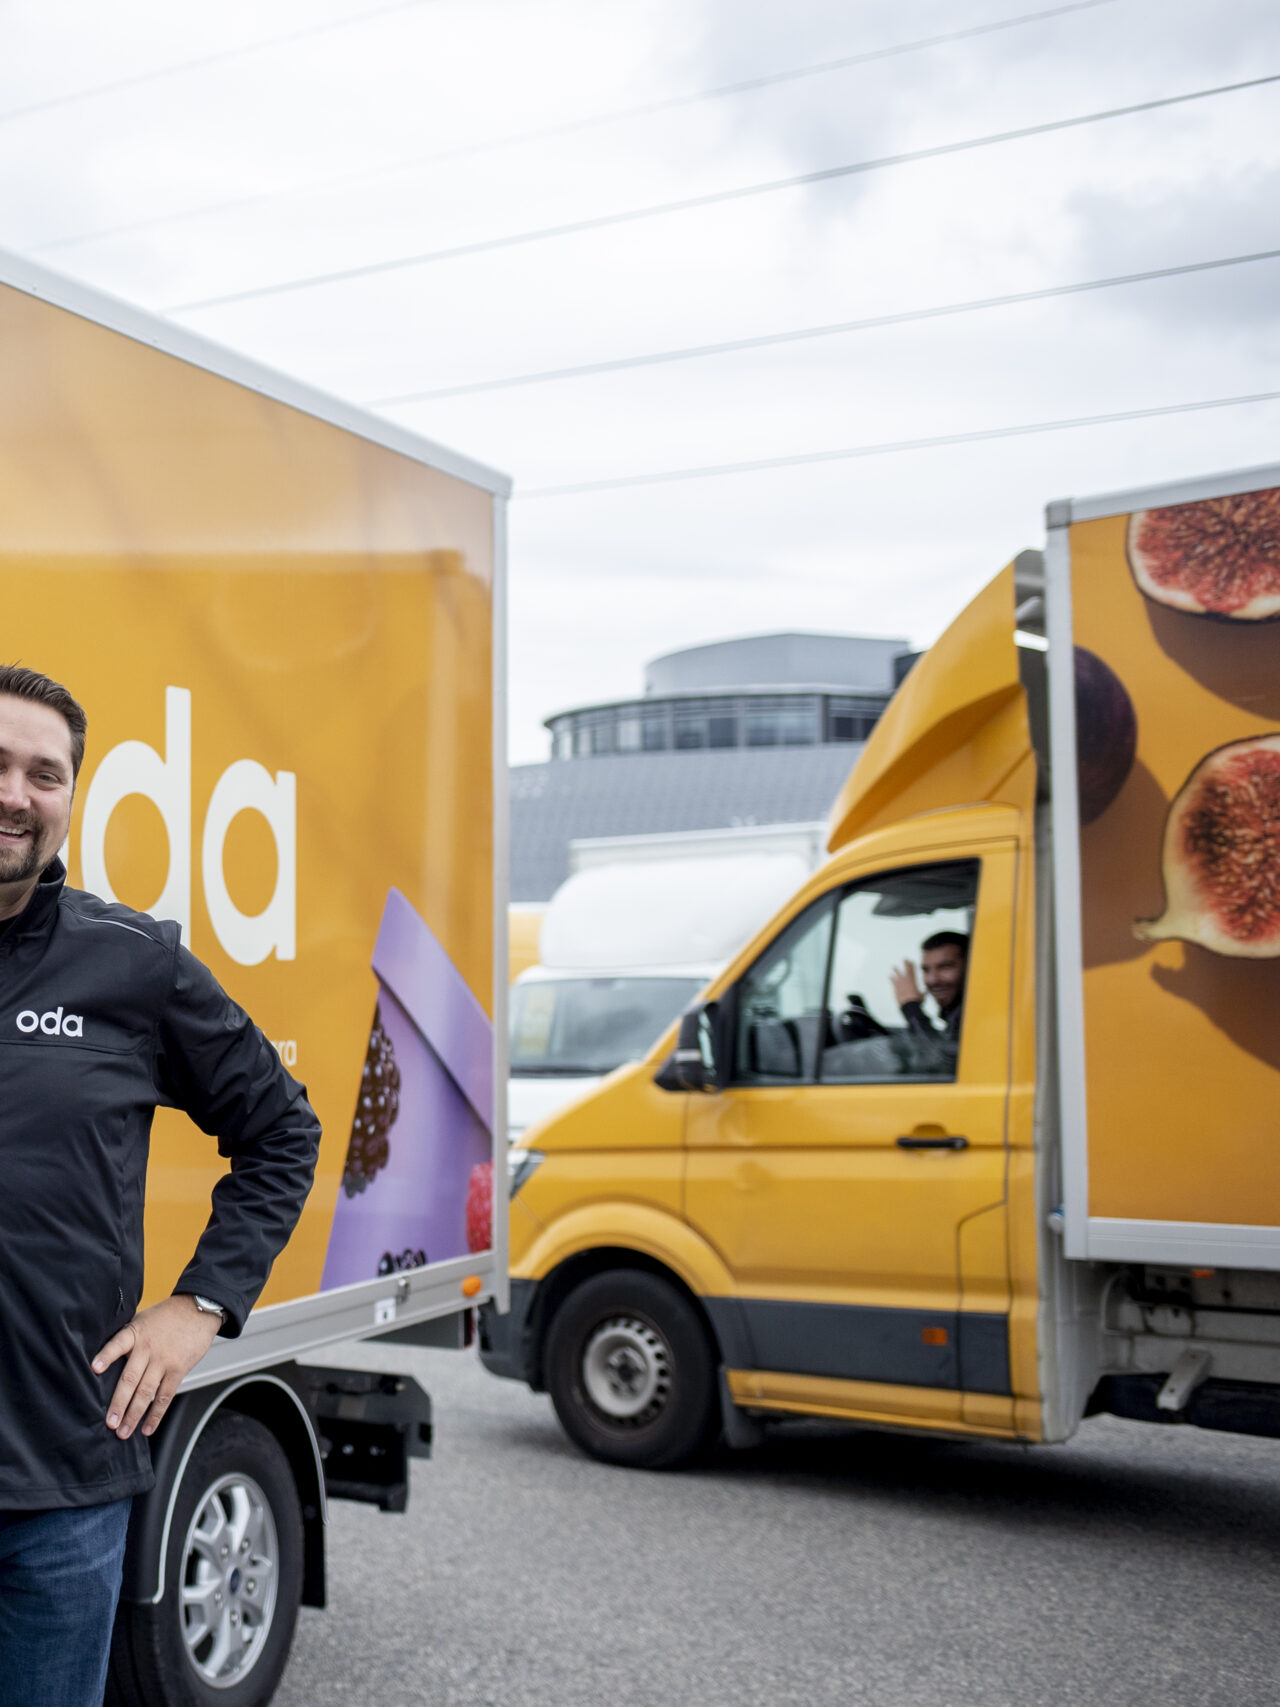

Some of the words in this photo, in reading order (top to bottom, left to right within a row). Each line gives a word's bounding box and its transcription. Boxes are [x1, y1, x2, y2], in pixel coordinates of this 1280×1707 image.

[57, 685, 297, 967] da
[16, 1006, 84, 1038] oda
[270, 1040, 297, 1067] ra
